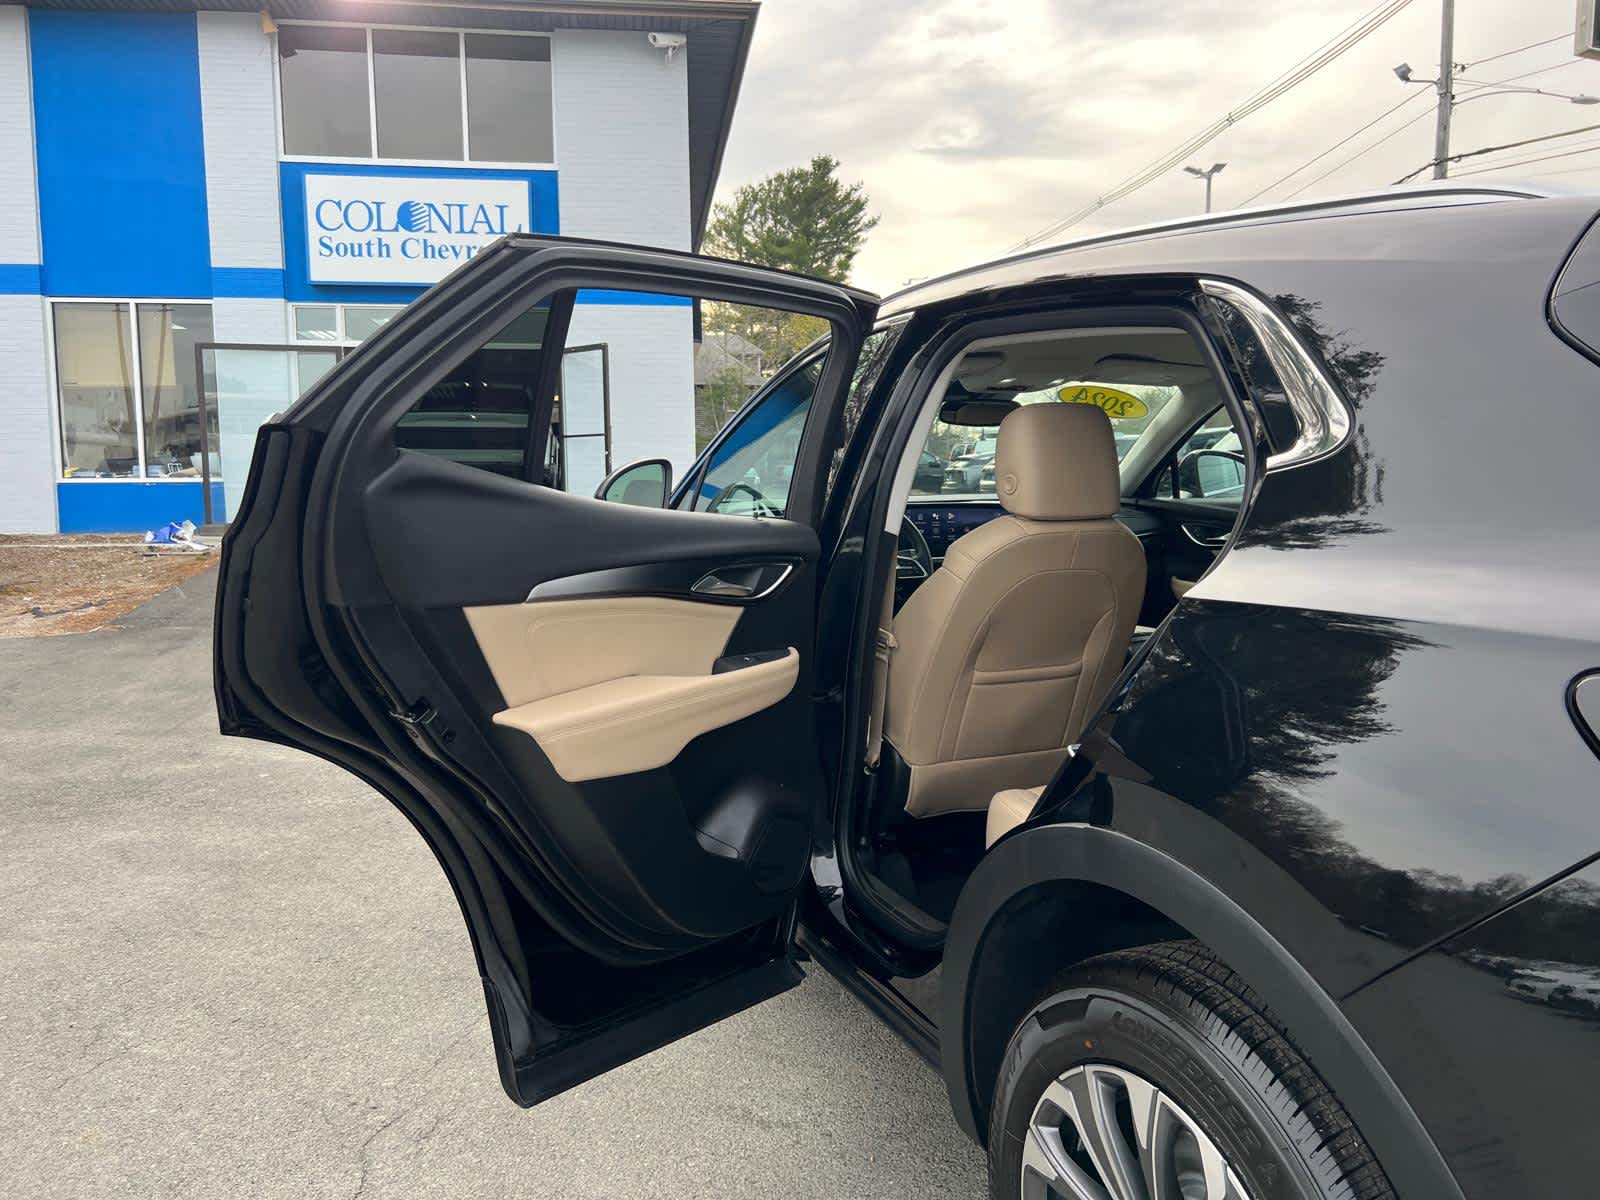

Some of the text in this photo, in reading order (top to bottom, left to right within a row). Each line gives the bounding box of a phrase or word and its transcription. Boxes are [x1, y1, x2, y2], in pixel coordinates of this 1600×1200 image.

[315, 199, 522, 234] COLONIAL
[318, 236, 486, 260] South Chevr
